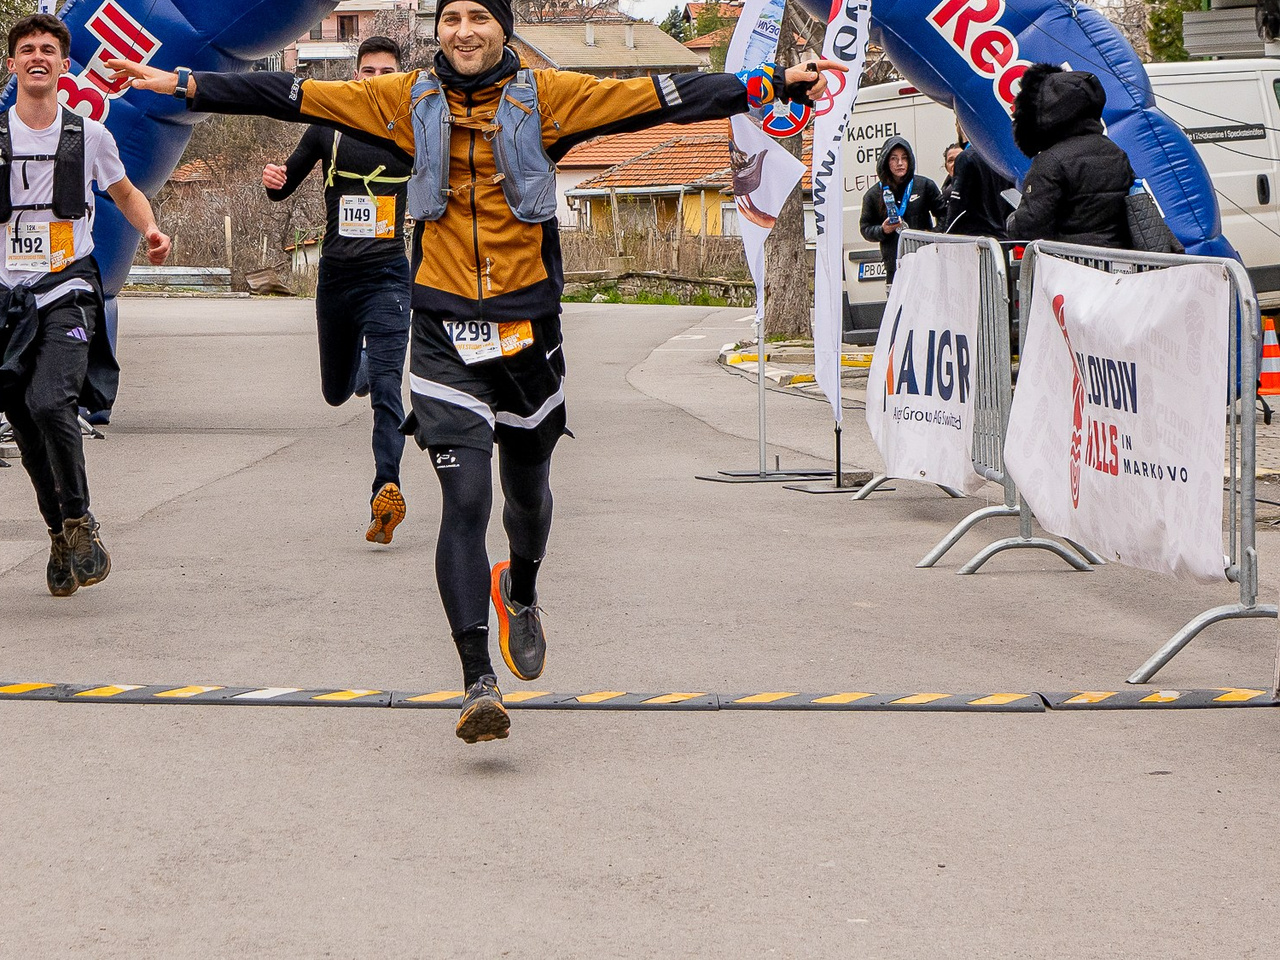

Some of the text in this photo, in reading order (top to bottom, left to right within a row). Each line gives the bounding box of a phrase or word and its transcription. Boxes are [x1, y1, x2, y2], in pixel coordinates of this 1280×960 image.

[847, 122, 901, 142] KACHEL
[344, 208, 370, 221] 1149
[447, 321, 491, 342] 1299
[1122, 434, 1132, 450] IN
[1123, 458, 1188, 483] MARKOVO
